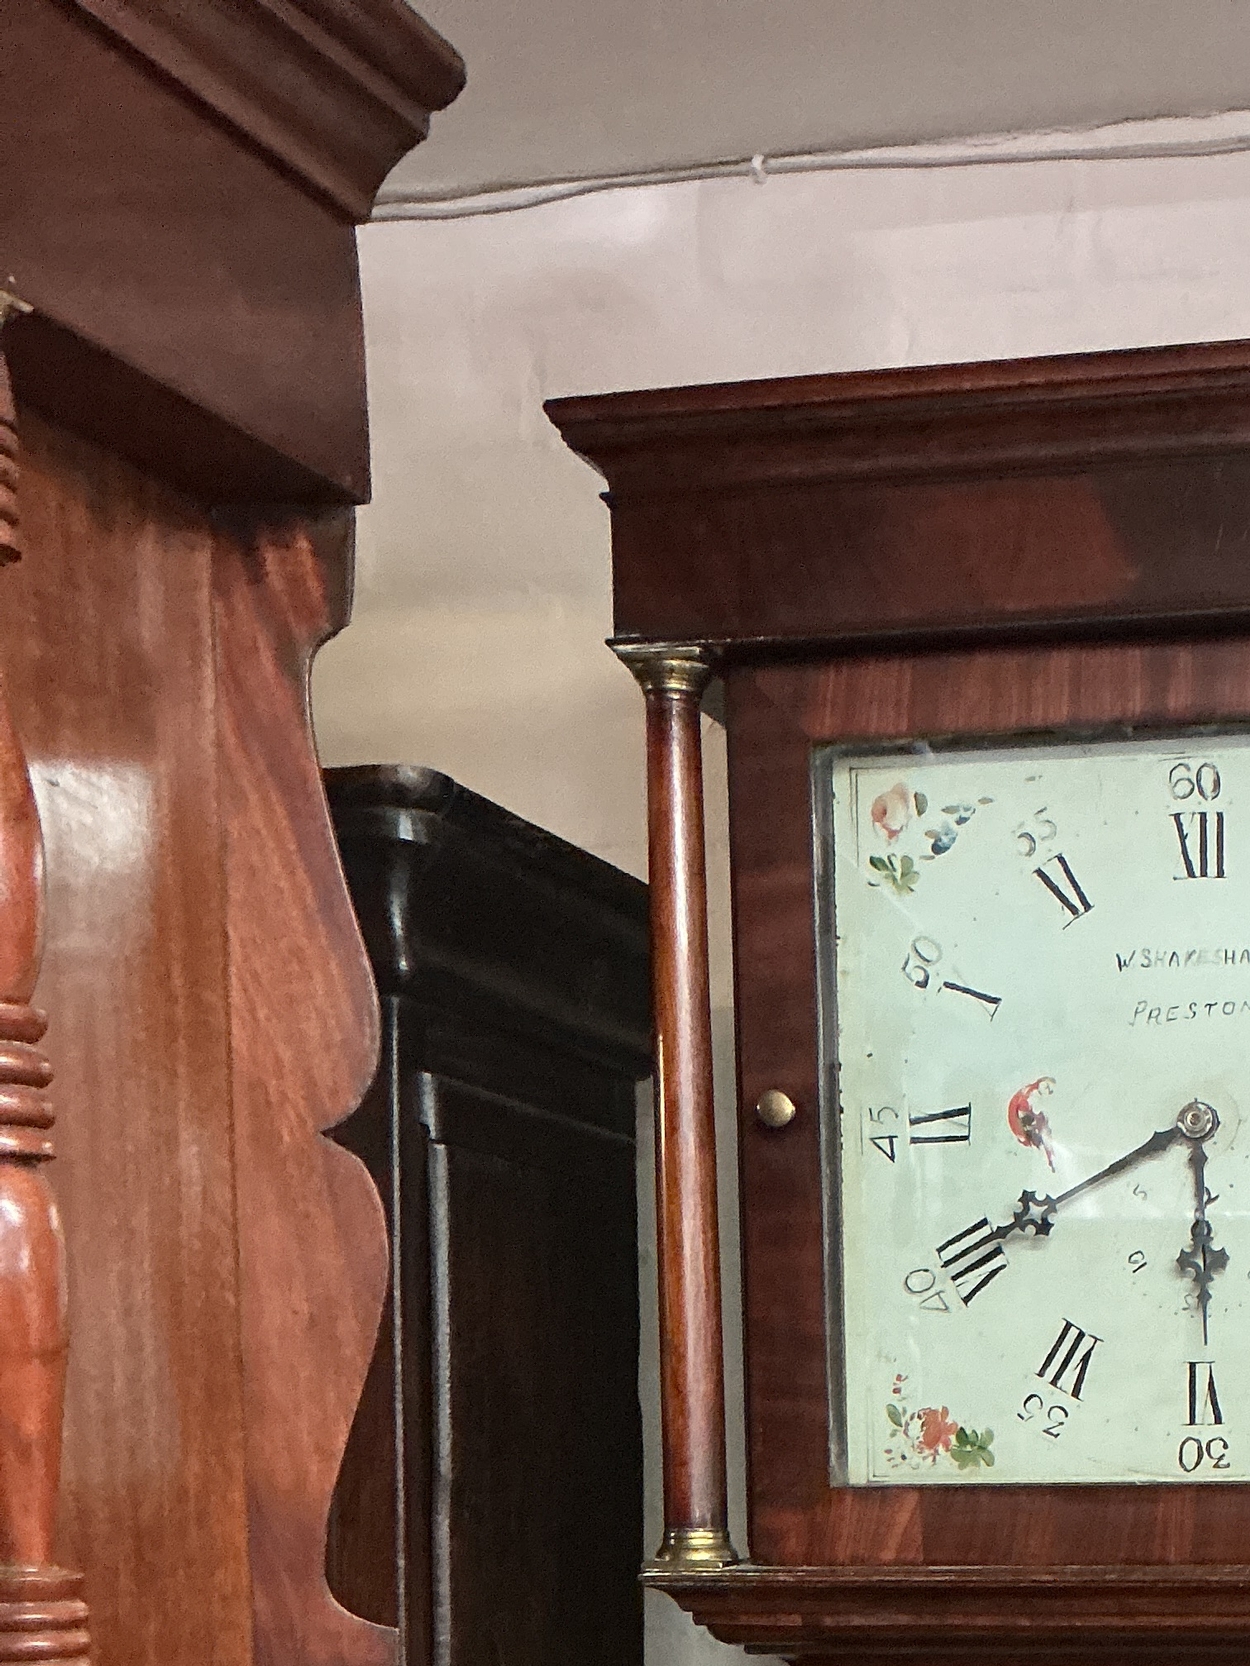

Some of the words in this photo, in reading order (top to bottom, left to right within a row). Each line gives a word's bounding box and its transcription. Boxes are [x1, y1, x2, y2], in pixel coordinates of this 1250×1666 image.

[1168, 762, 1221, 801] 60
[901, 935, 943, 989] 50
[869, 1106, 899, 1163] 45
[903, 1267, 952, 1313] 40
[1016, 1392, 1069, 1439] 35
[1177, 1360, 1225, 1426] VI
[1178, 1435, 1231, 1473] 30
